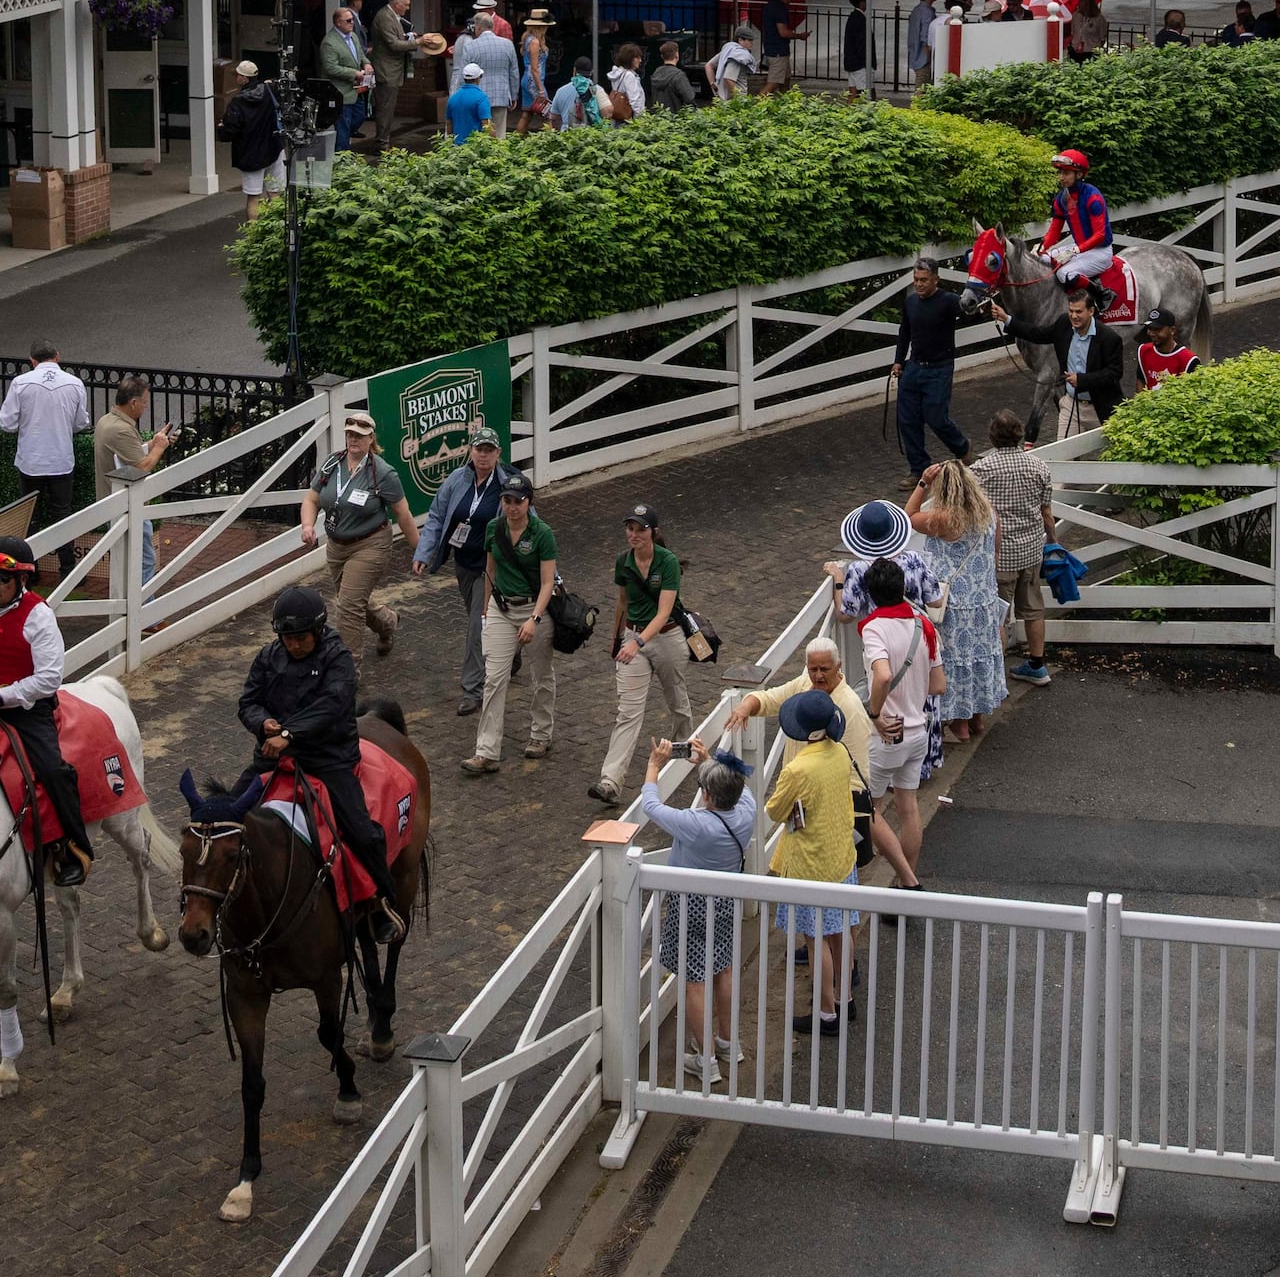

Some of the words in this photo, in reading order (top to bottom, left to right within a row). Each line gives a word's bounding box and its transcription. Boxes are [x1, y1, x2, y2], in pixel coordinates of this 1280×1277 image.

[1121, 263, 1135, 301] 1
[407, 382, 476, 417] BELMONT
[420, 403, 467, 434] STAKES
